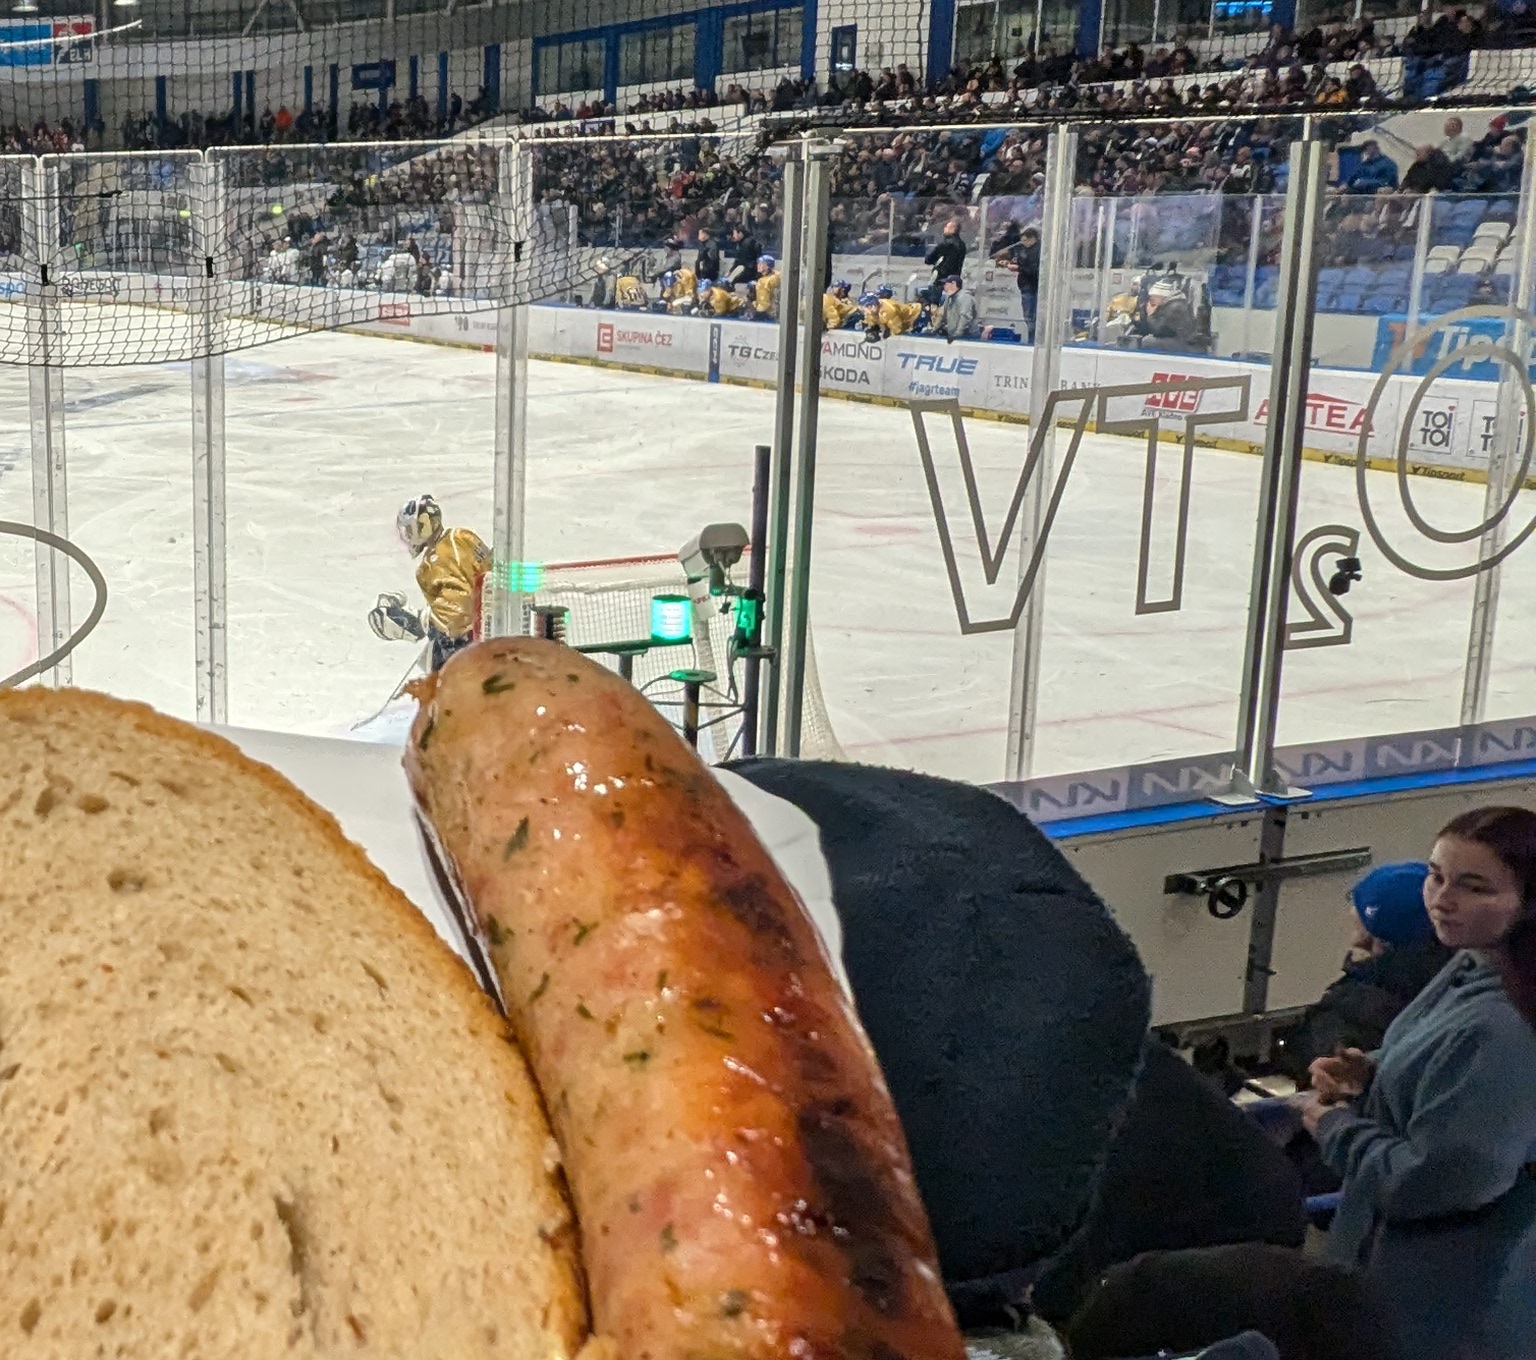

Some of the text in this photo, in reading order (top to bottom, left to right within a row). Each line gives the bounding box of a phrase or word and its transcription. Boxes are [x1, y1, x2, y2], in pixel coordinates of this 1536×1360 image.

[616, 330, 673, 346] SKUPINA ČEZ
[728, 345, 752, 359] TG
[897, 352, 979, 376] TRUE
[909, 380, 960, 397] #jagrteam
